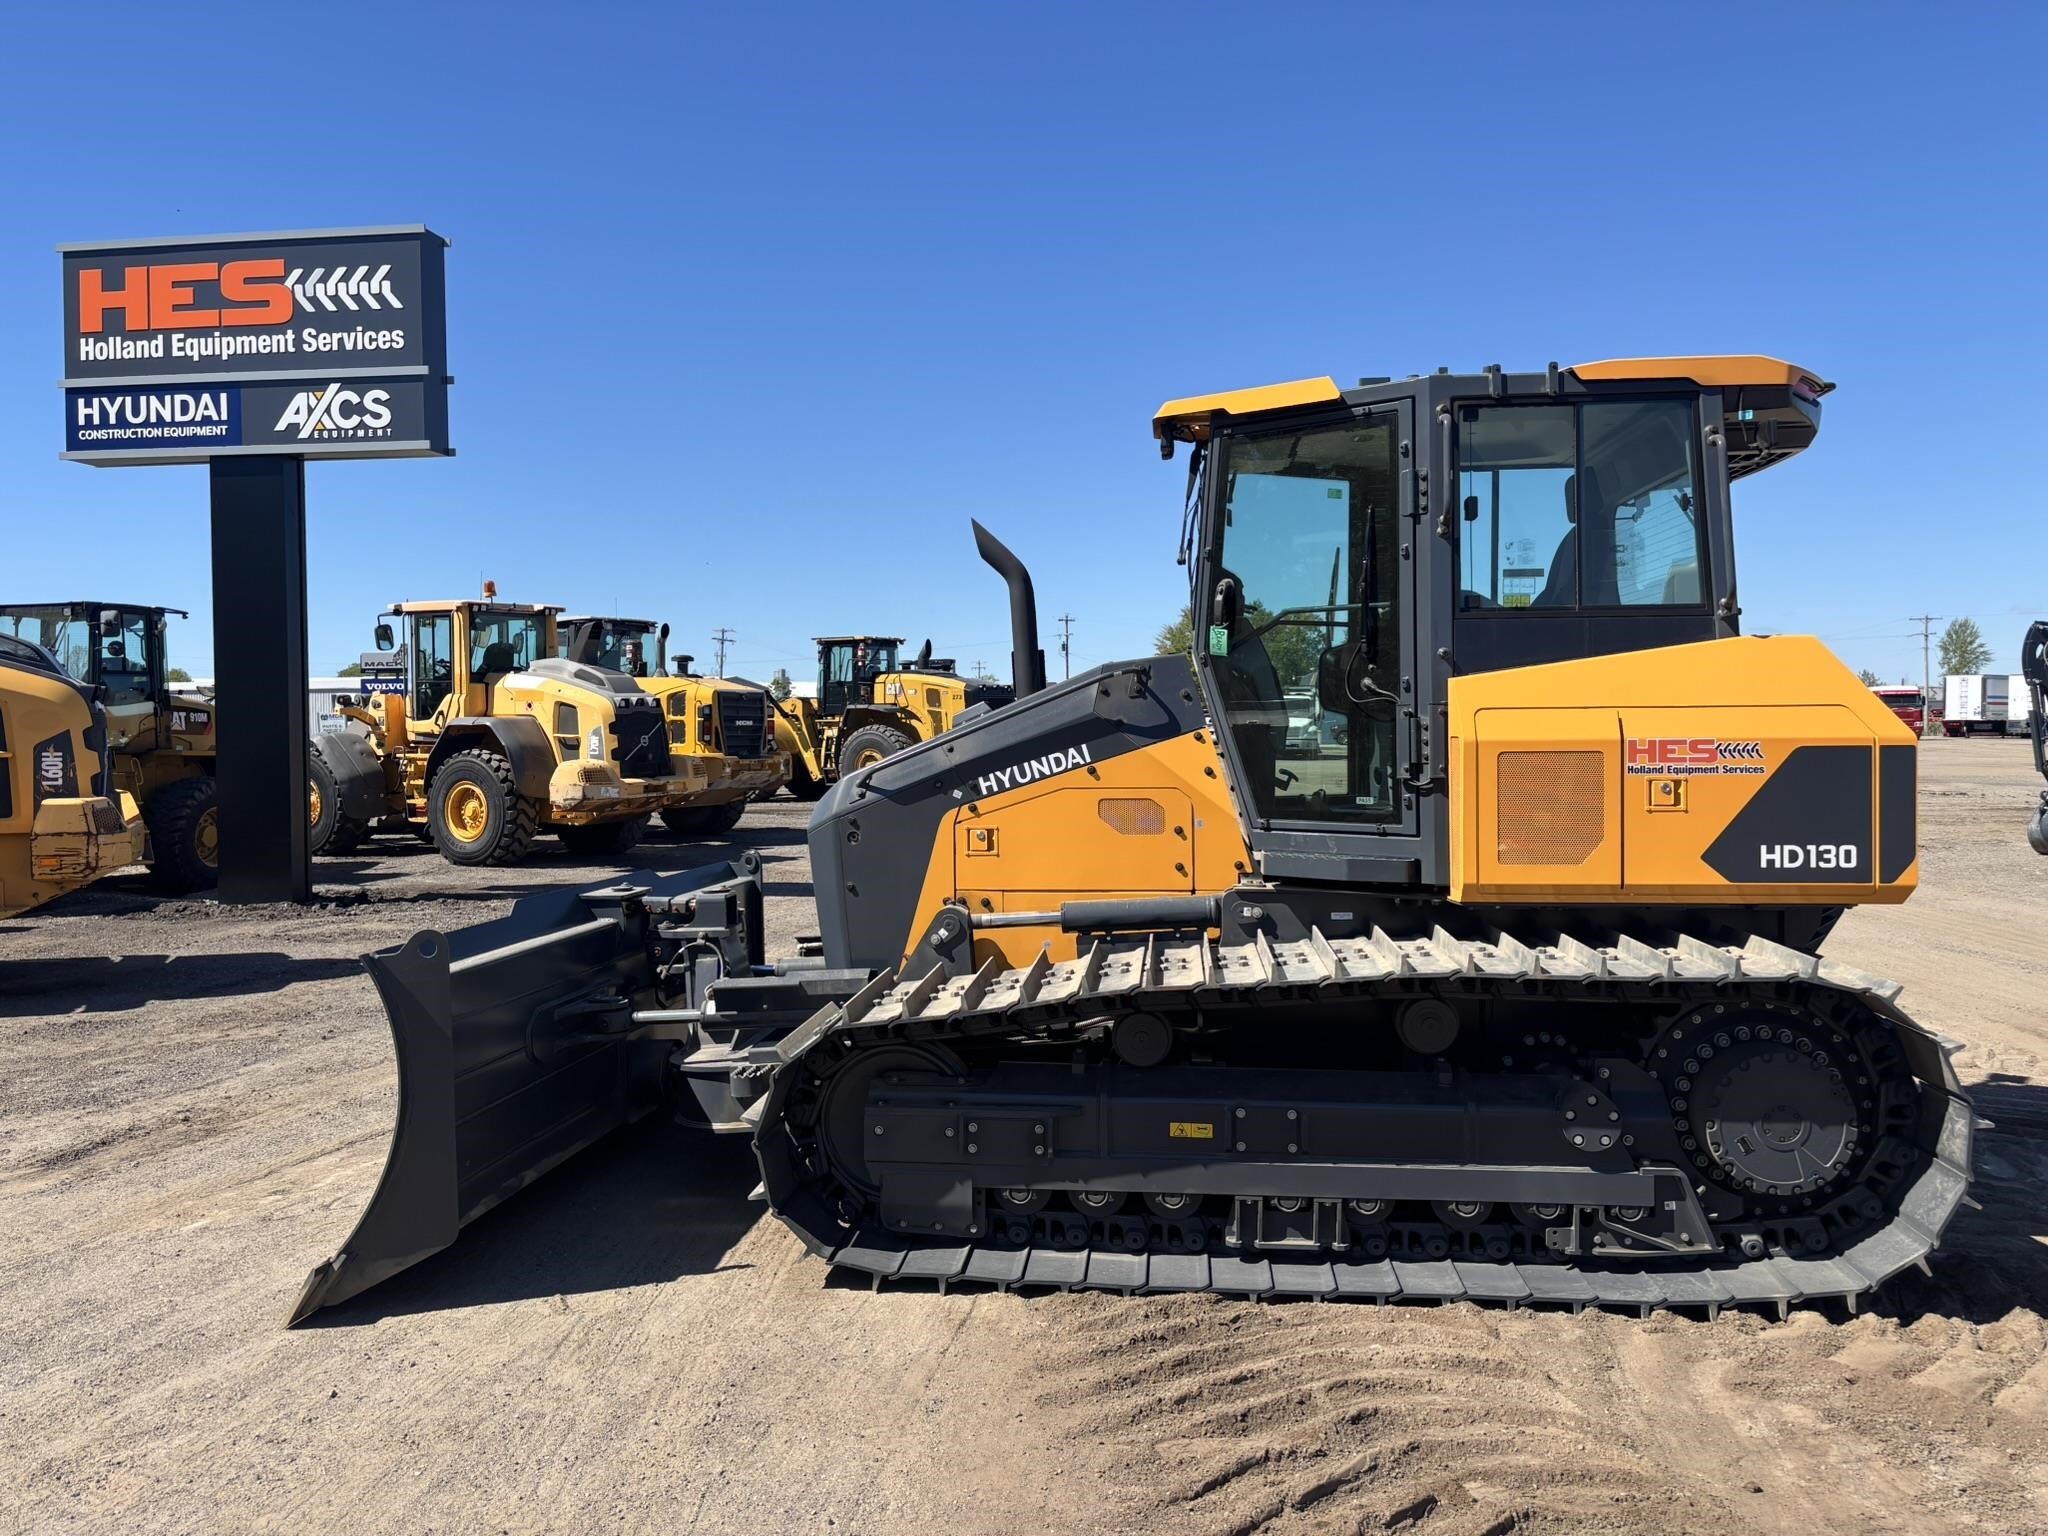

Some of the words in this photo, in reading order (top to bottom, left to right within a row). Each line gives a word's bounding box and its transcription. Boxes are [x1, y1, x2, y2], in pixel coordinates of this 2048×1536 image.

[79, 259, 293, 333] HES
[80, 334, 163, 361] Holland
[172, 329, 295, 361] Equipment
[302, 326, 405, 352] Services
[77, 392, 229, 426] HYUNDAI
[273, 382, 392, 439] AXCS
[78, 427, 163, 440] CONSTRUCTION
[164, 425, 229, 438] EQUIPMENT
[313, 428, 393, 439] EQUIPMENT
[365, 683, 405, 691] VOLVO
[886, 683, 901, 698] CAT
[171, 711, 187, 731] AT
[1627, 738, 1720, 764] HES
[41, 751, 63, 786] L60H
[978, 743, 1092, 796] HYUNDAI
[1627, 765, 1664, 775] Holland
[1667, 765, 1720, 776] Equipment
[1722, 765, 1765, 775] Services
[1760, 844, 1858, 869] HD130
